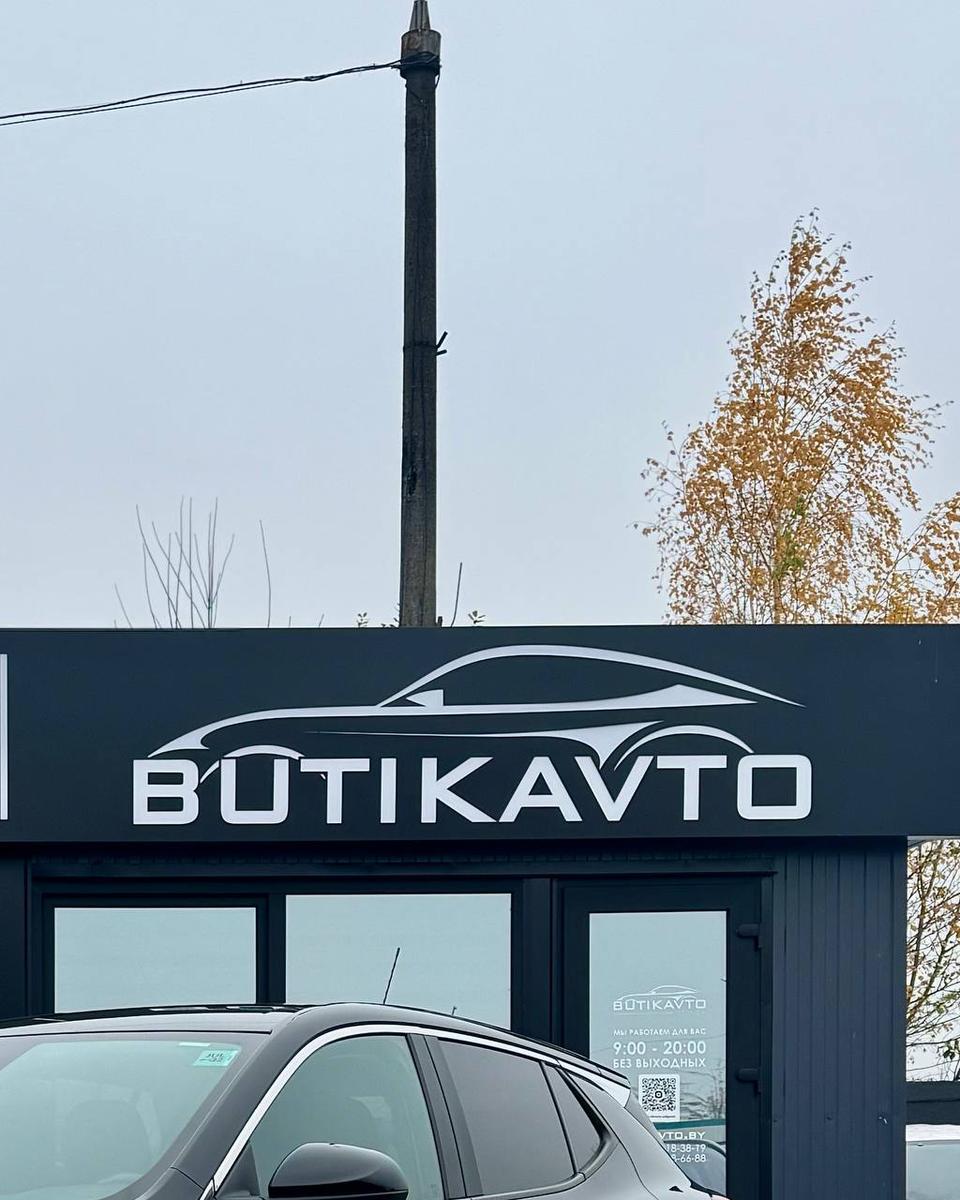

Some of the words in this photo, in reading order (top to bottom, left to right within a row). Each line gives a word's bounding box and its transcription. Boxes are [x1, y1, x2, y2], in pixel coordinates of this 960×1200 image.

[133, 753, 813, 825] BUTIKAVTO
[613, 999, 706, 1010] BUTIKAVTO
[614, 1028, 627, 1036] МЫ
[629, 1028, 670, 1036] РАБОТАЕМ
[672, 1028, 688, 1036] ДЛЯ
[613, 1041, 646, 1055] 9:00
[663, 1041, 706, 1054] 20:00
[613, 1058, 632, 1068] БЕЗ
[635, 1058, 706, 1068] ВЫХОДНЫХ
[658, 1131, 706, 1140] VTO.BY
